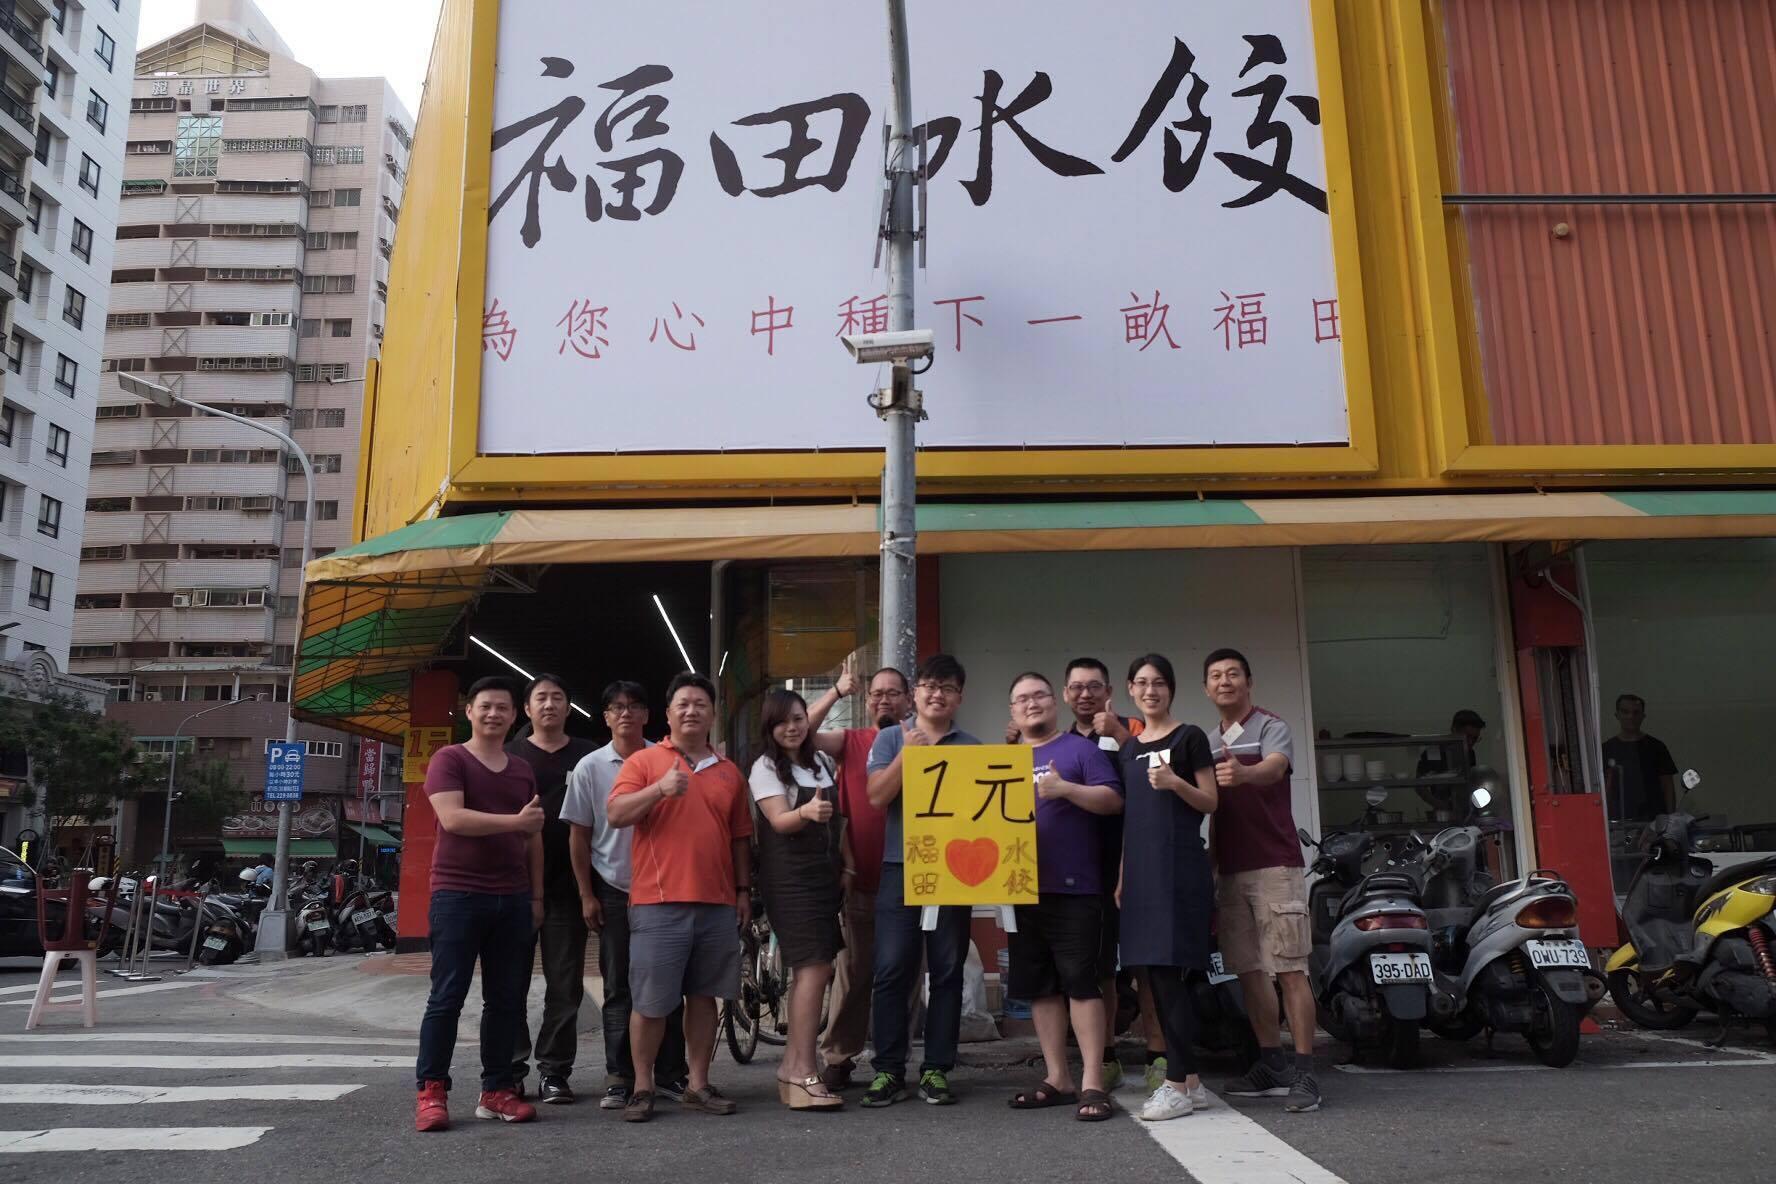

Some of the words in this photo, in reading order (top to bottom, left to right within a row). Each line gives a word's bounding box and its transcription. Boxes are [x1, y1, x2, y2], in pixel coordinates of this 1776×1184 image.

[488, 35, 1329, 249] 福田水餃
[270, 747, 283, 763] P
[362, 738, 377, 792] 當歸鴨
[1375, 963, 1431, 979] 395-DAD
